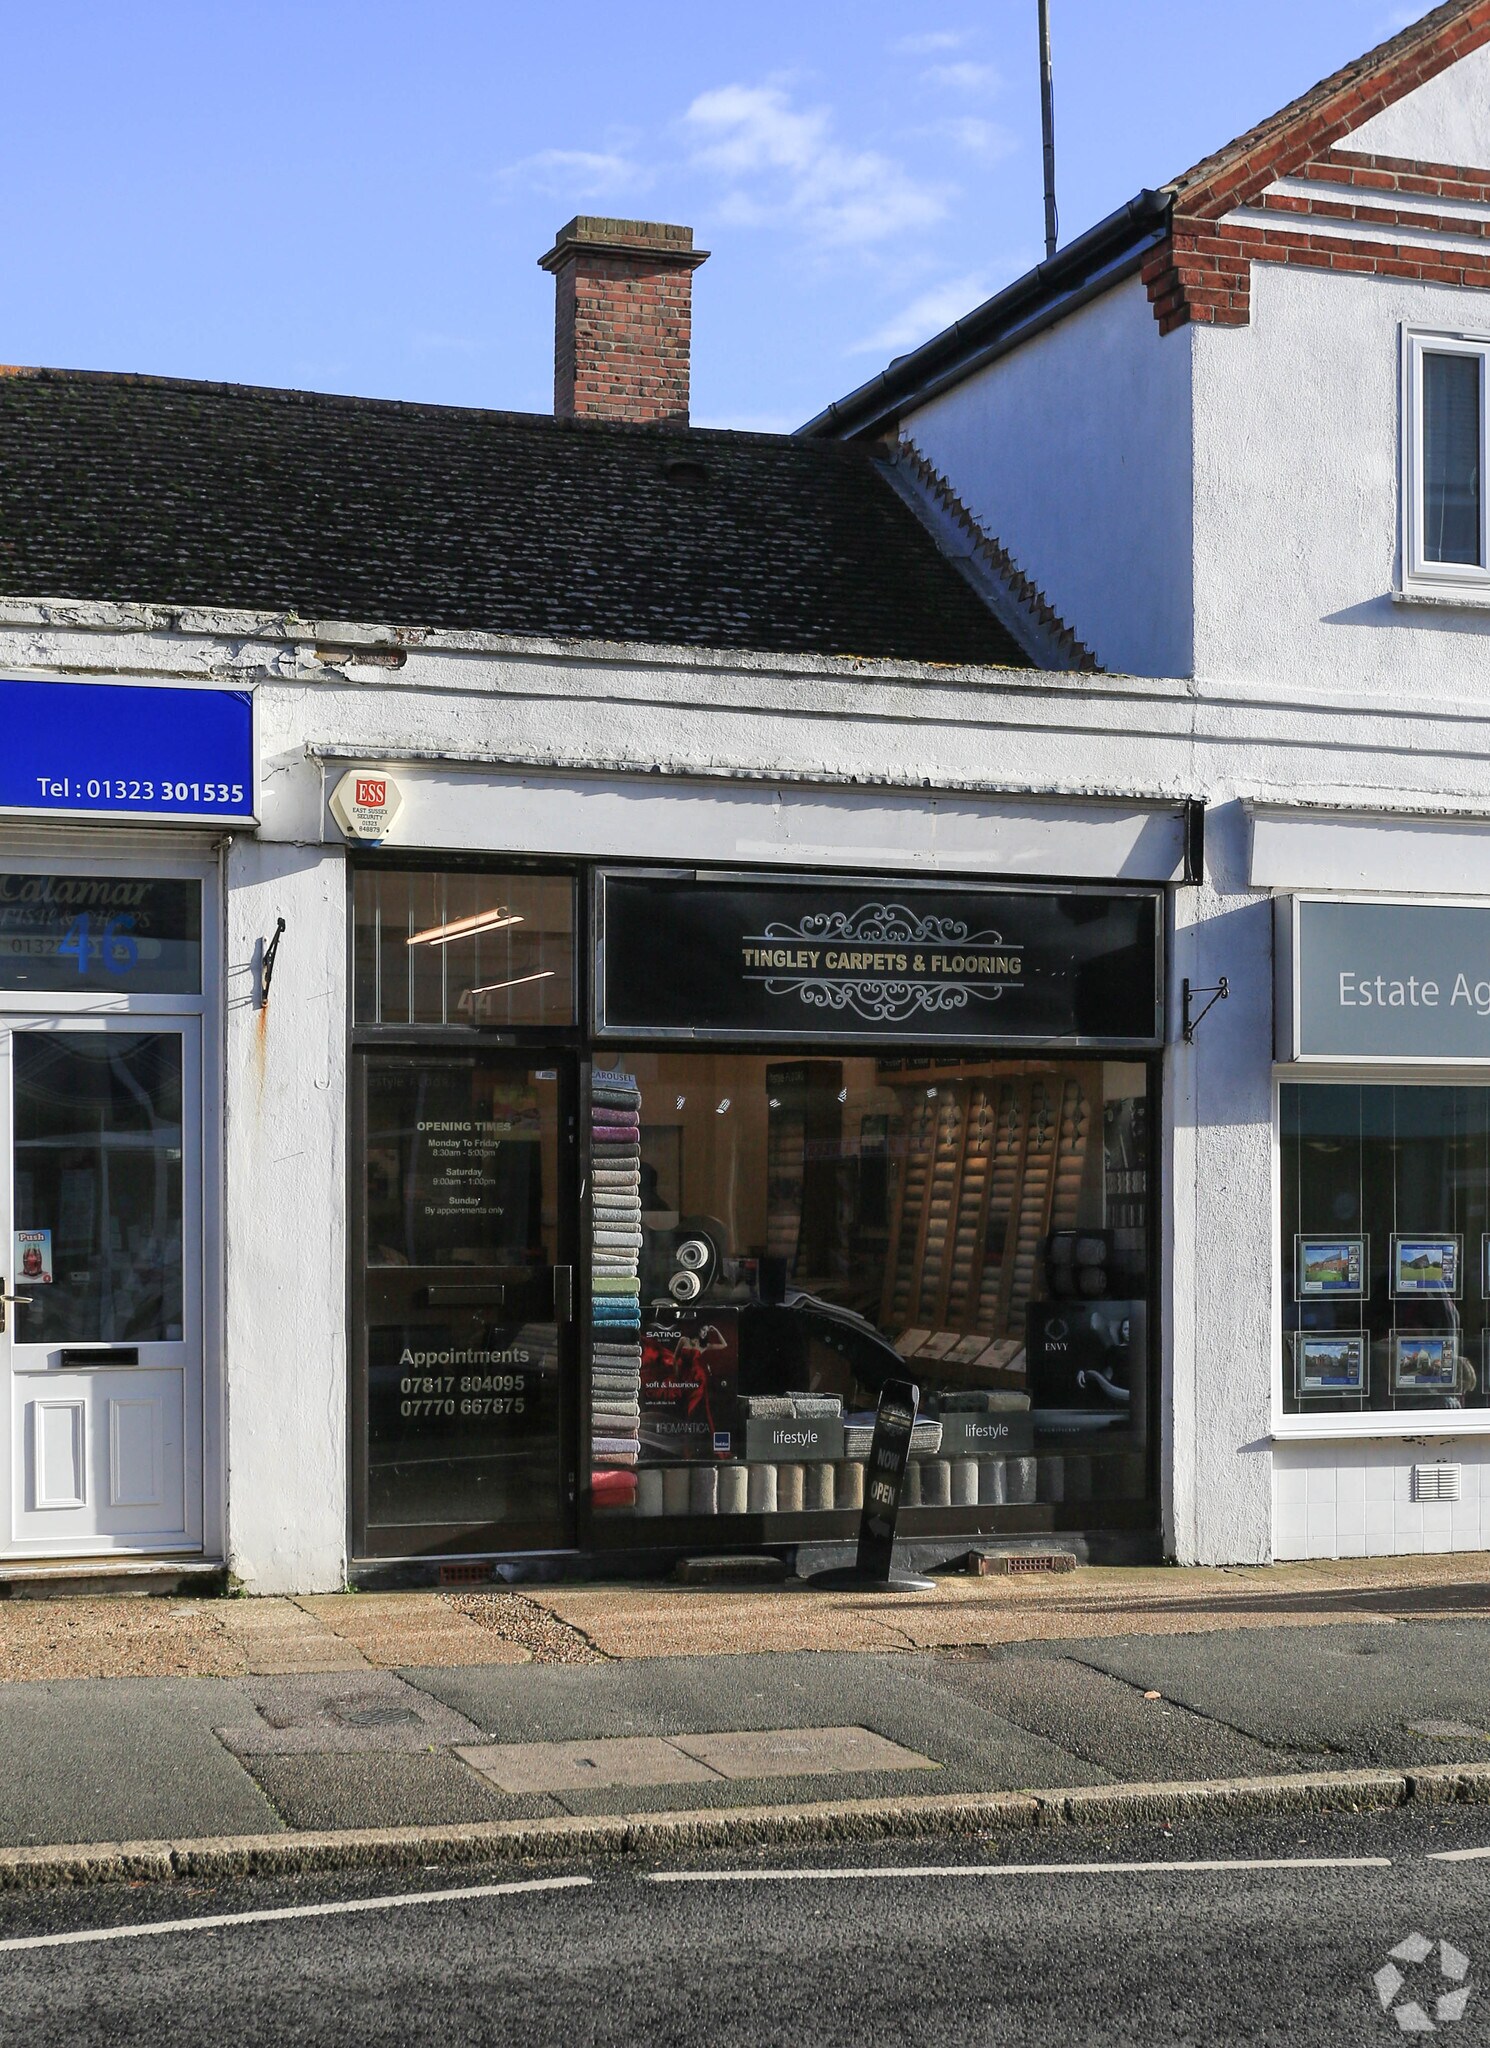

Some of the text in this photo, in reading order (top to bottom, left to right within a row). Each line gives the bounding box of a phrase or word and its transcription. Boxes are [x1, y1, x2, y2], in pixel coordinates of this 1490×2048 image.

[37, 777, 69, 797] Tel
[87, 779, 155, 800] 01323
[161, 782, 244, 803] 301535
[359, 783, 384, 803] ESS
[0, 873, 153, 906] Calamar
[57, 911, 139, 976] 46
[742, 947, 1022, 976] TINGLEY CARPETS & FLOORING
[1339, 972, 1440, 1006] Estate
[417, 1121, 511, 1132] OPENING TIMES
[428, 1139, 501, 1149] Monday To Friday
[467, 1149, 496, 1158] 5:00pm
[446, 1167, 483, 1177] Saturday
[432, 1178, 461, 1186] 9:00am
[468, 1178, 496, 1187] 1:00pm
[449, 1196, 480, 1206] Sunday
[425, 1206, 436, 1215] By
[488, 1206, 504, 1215] only
[19, 1232, 45, 1242] Push
[1045, 1342, 1069, 1351] ENVY
[399, 1347, 529, 1369] Appointments
[400, 1375, 525, 1394] 07817 804095
[645, 1380, 660, 1388] soft
[668, 1380, 700, 1388] luxurious
[400, 1397, 525, 1417] 07770 667875
[773, 1430, 818, 1447] lifestyle
[965, 1424, 1009, 1440] lifestyle
[876, 1447, 901, 1471] NOW
[870, 1480, 896, 1505] OPEN
